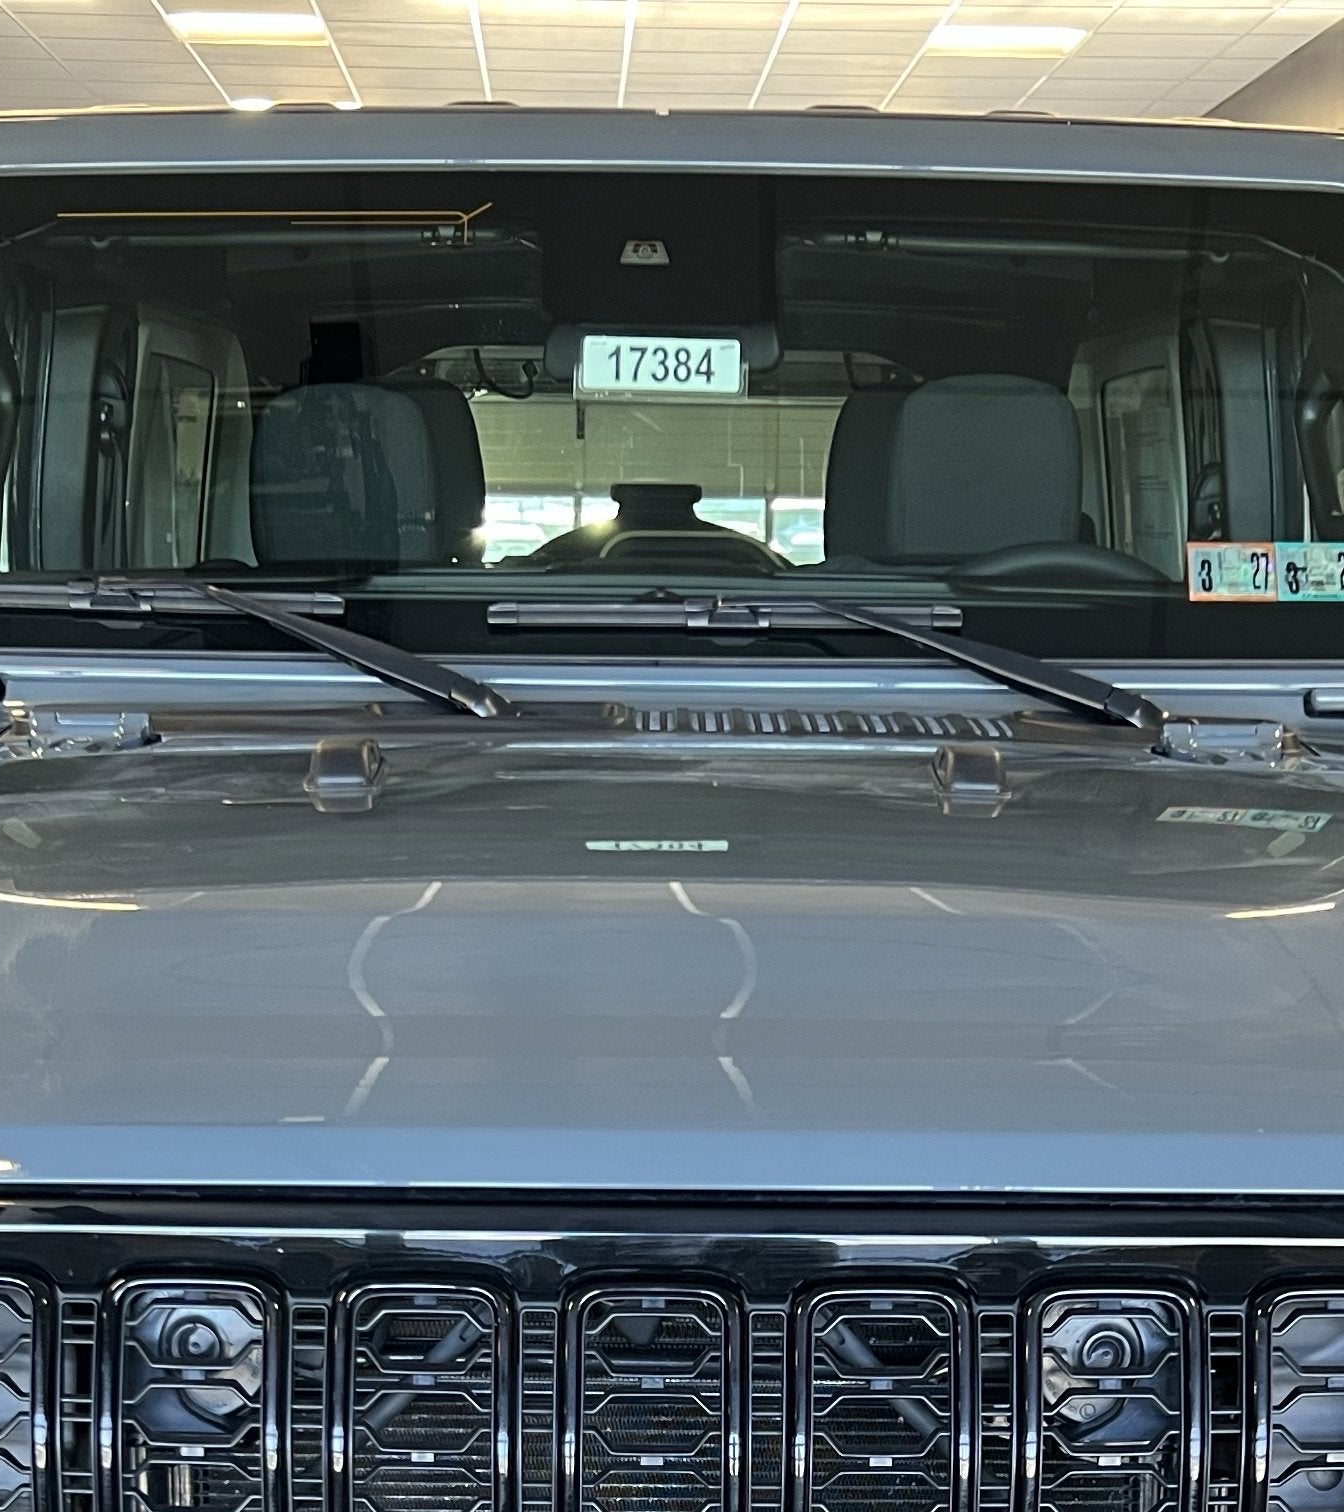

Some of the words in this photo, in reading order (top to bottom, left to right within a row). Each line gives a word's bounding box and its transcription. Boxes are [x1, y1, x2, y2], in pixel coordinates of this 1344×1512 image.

[608, 345, 715, 384] 17384
[1200, 559, 1213, 592] 3
[1250, 552, 1269, 592] 27
